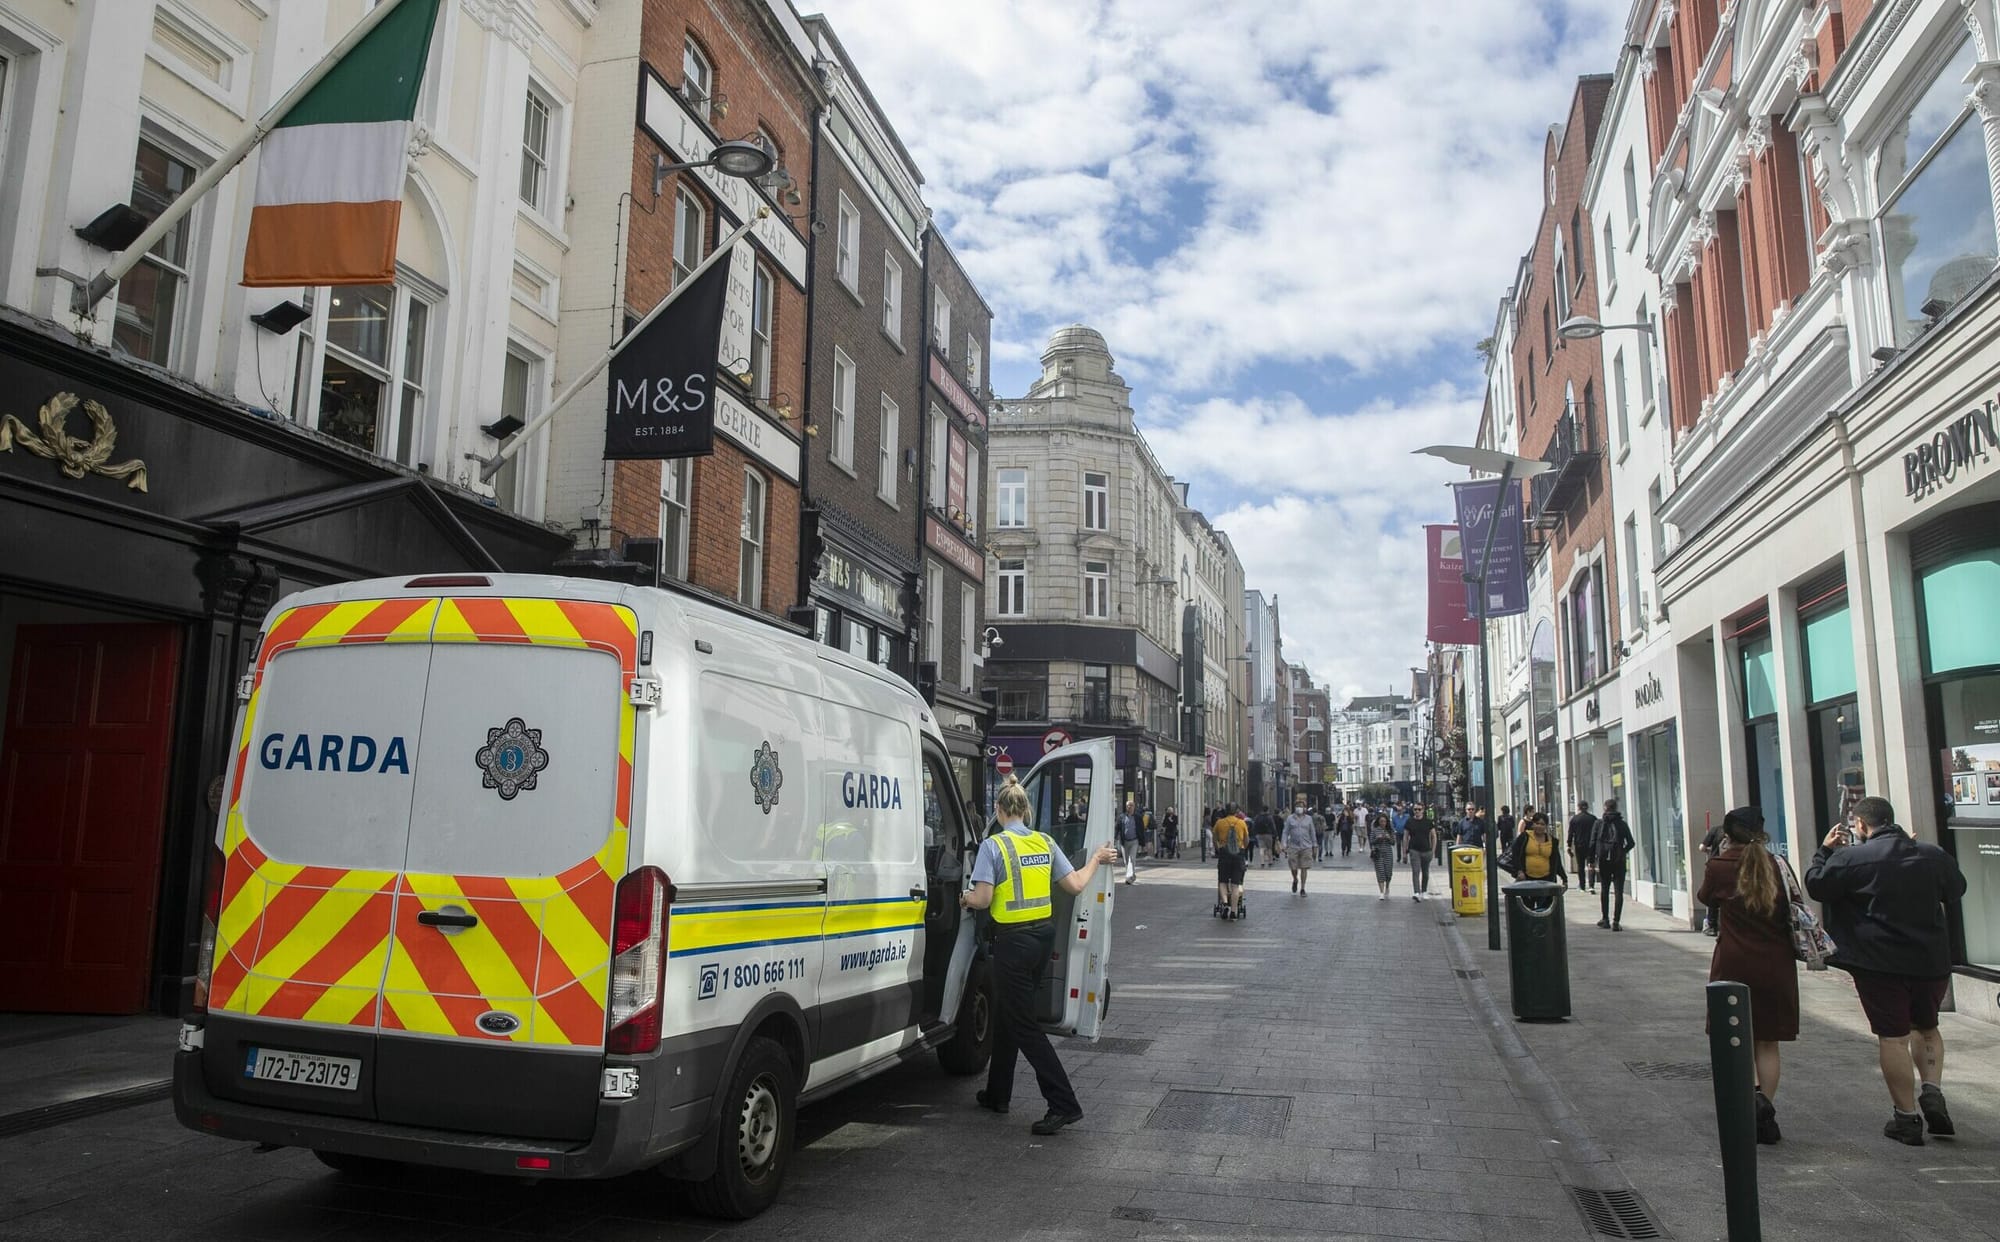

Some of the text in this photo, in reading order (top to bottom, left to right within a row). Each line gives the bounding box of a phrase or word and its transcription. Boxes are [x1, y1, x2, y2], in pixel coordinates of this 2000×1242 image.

[729, 274, 751, 308] IFTS
[615, 373, 706, 415] M&S
[635, 425, 685, 437] EST. 1884
[829, 554, 850, 590] M&S
[964, 548, 976, 572] BAR
[1440, 561, 1464, 570] Kaize
[260, 733, 409, 774] GARDA
[842, 771, 902, 810] GARDA
[1021, 855, 1049, 865] GARDA
[840, 940, 907, 971] www.garda.ie
[722, 957, 805, 990] 1 800 666 111
[260, 1056, 351, 1087] 172-D-23179
